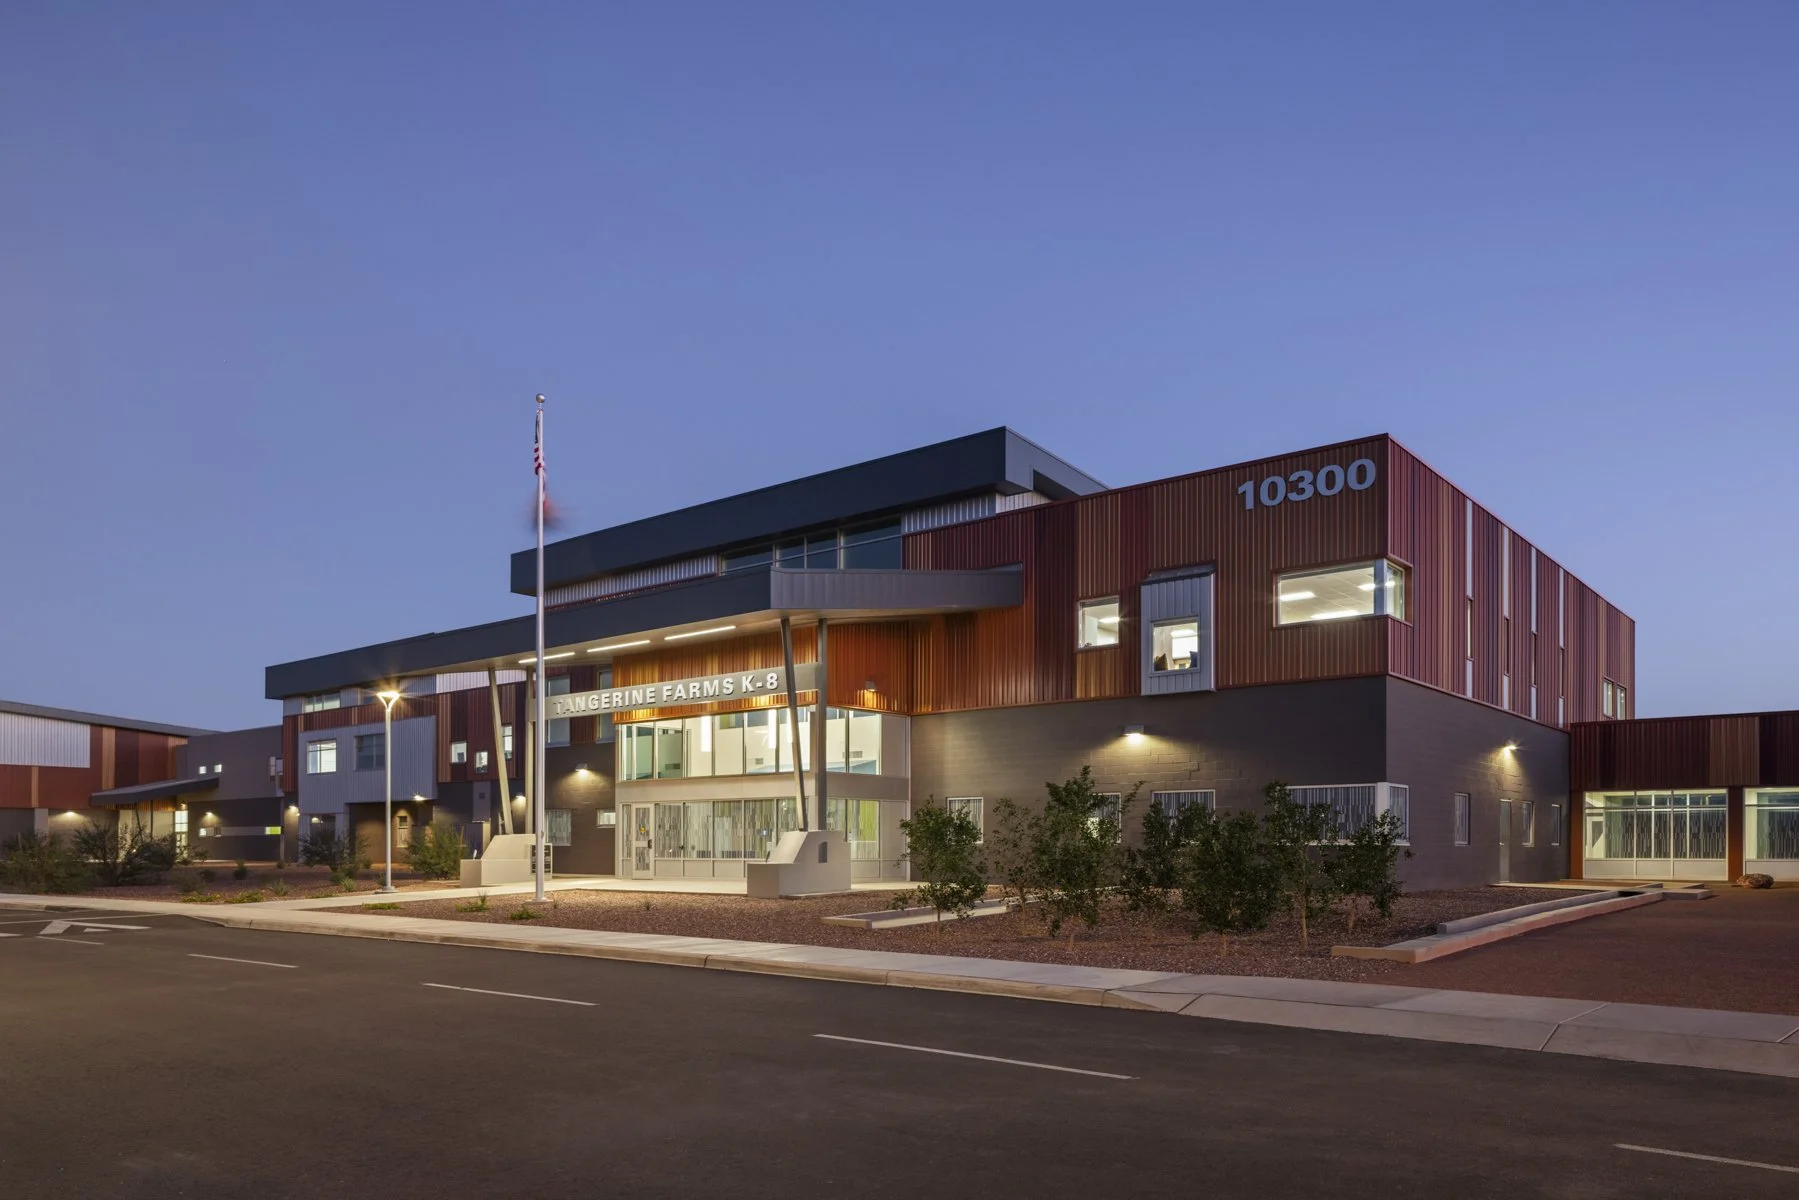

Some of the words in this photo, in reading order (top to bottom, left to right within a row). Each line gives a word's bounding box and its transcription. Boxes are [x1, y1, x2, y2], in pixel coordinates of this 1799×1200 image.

[1237, 458, 1376, 510] 10300
[553, 687, 656, 714] TANGERINE
[663, 677, 734, 702] FARMS
[742, 672, 779, 693] K-8
